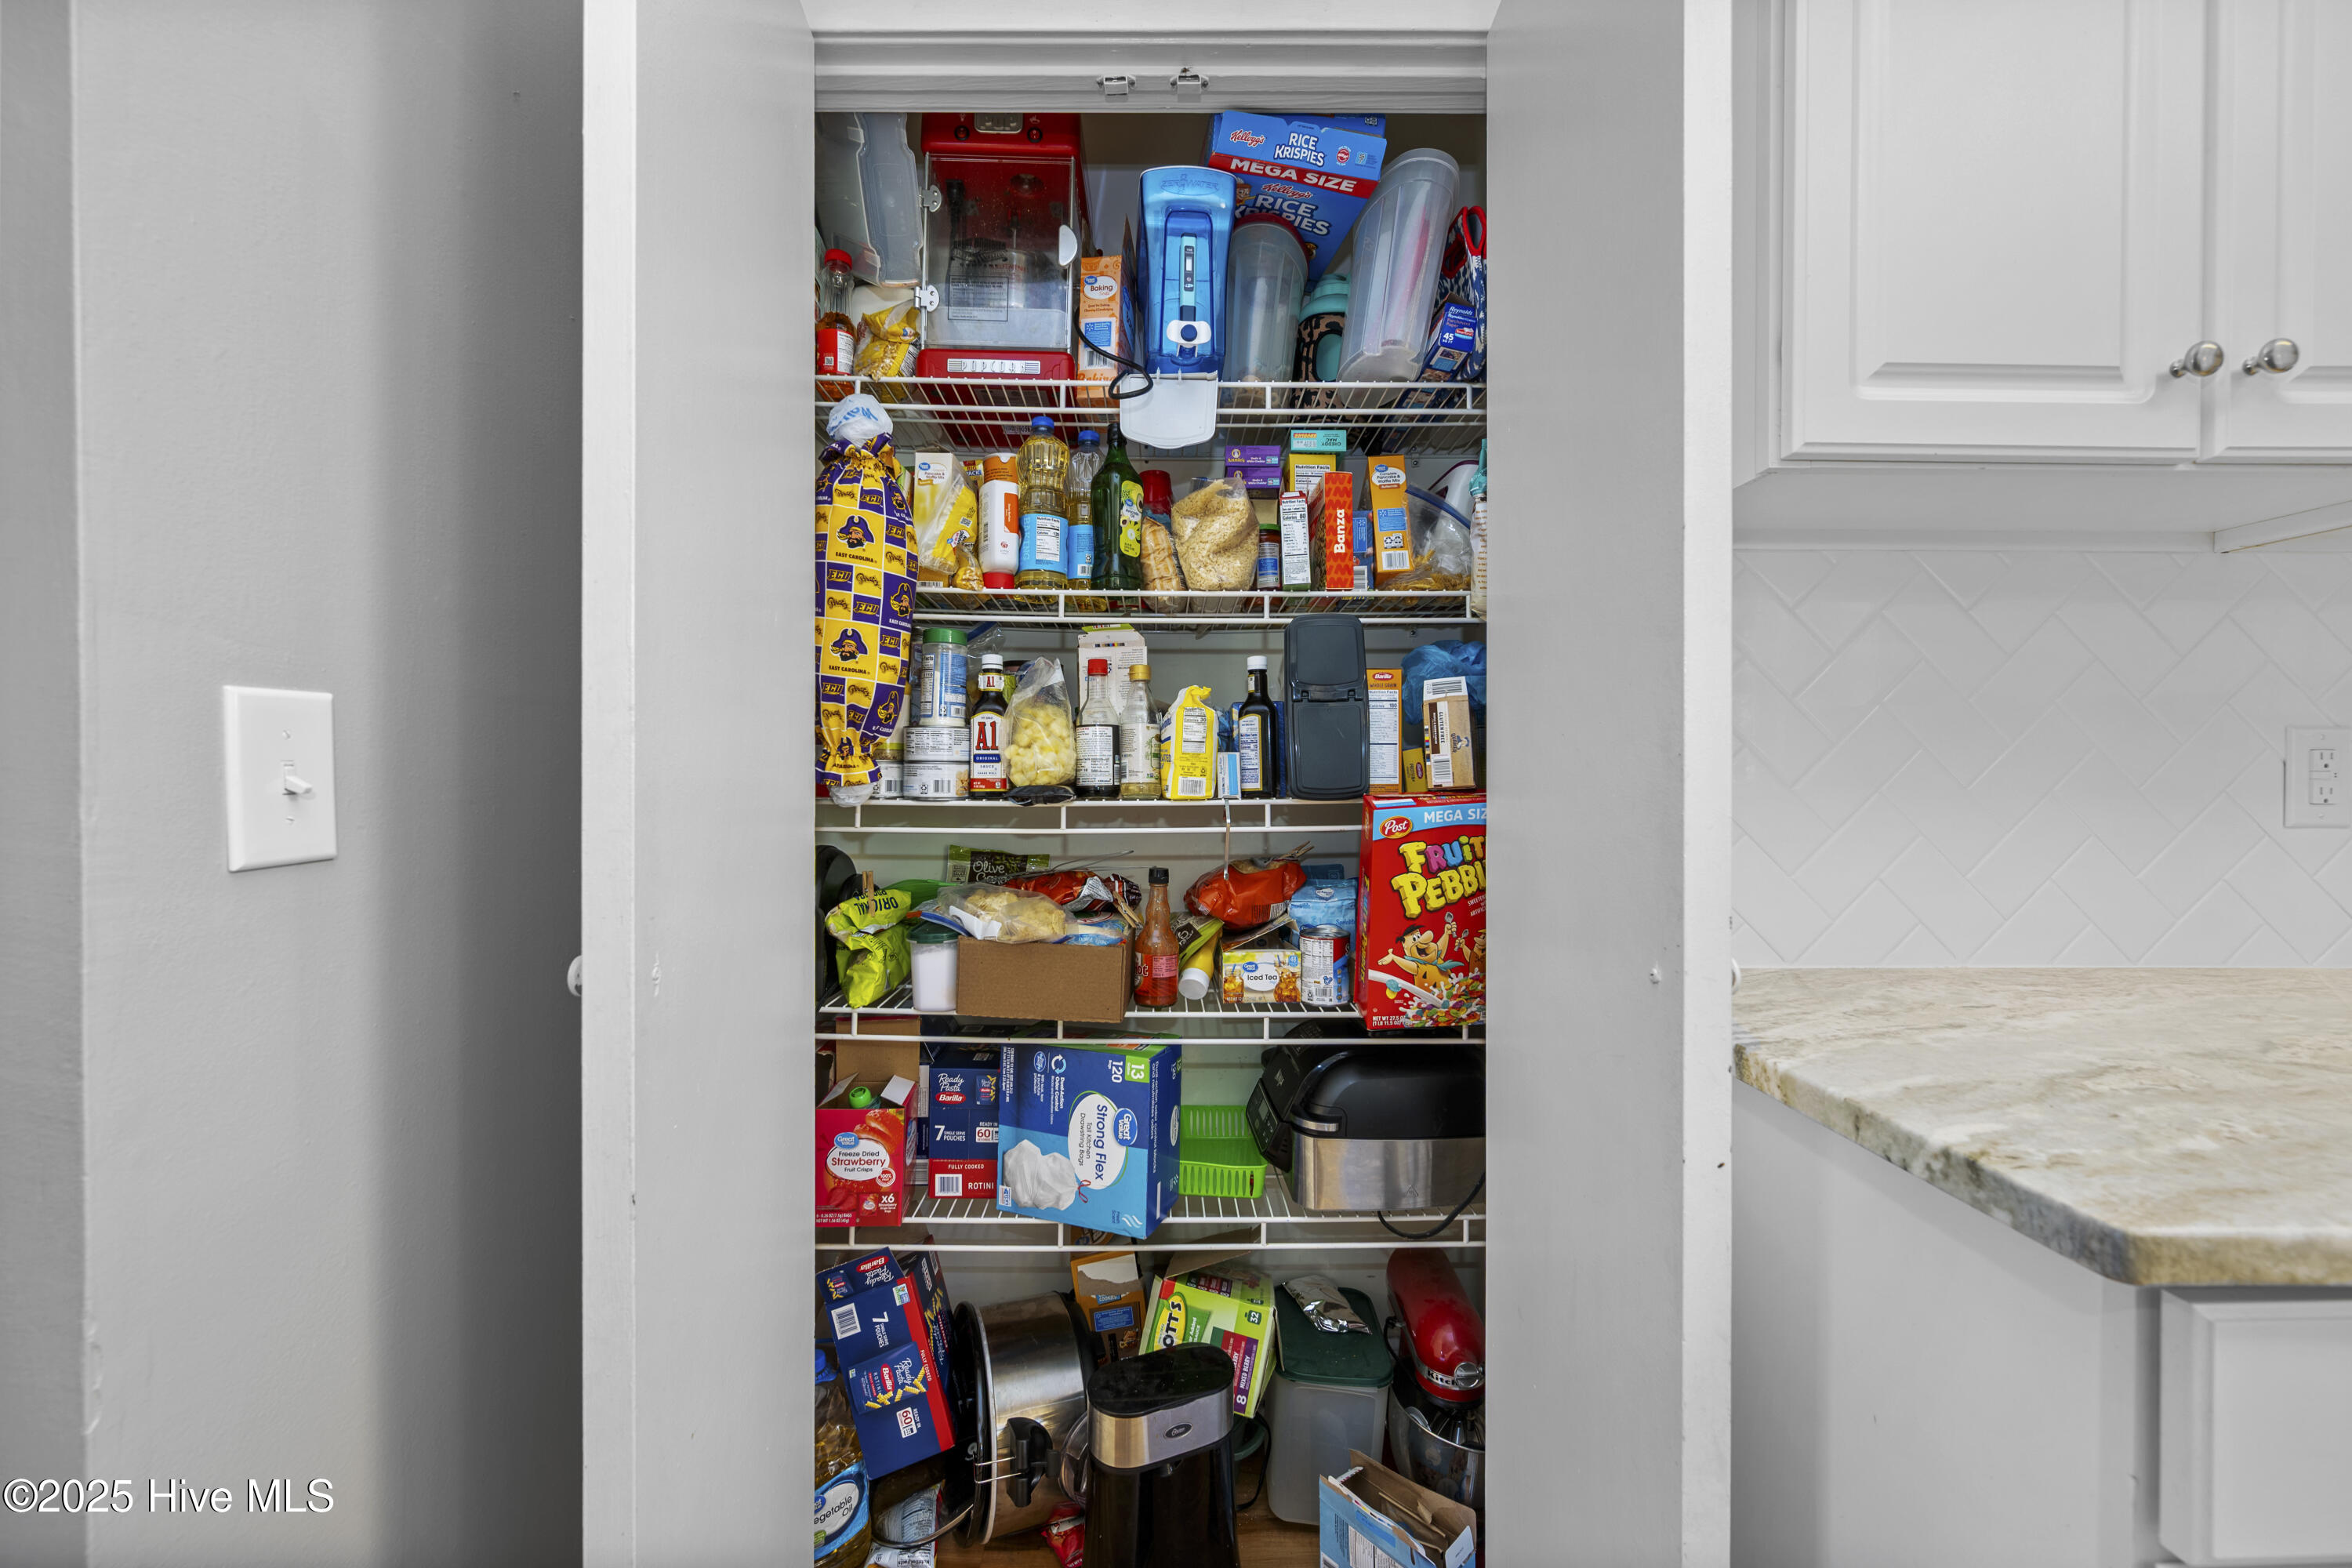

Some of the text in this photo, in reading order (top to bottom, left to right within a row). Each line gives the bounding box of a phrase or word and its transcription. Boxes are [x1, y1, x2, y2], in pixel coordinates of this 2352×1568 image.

[1230, 129, 1265, 147] Kellogg's
[1289, 132, 1318, 150] RICE
[1274, 145, 1324, 167] KRISPIES
[1231, 158, 1357, 192] MEGA SIZE
[1261, 183, 1313, 199] Kellogg's
[1254, 194, 1316, 217] RICE
[1449, 307, 1473, 315] Reynolds
[861, 495, 882, 505] ECU
[886, 524, 905, 539] ECU
[1334, 508, 1345, 554] Banza
[849, 554, 873, 563] CAROLINA
[827, 569, 852, 582] ECU
[854, 601, 879, 615] ECU
[880, 635, 899, 648] ECU
[822, 683, 844, 695] ECU
[987, 676, 995, 688] A1
[975, 721, 999, 750] A1
[1424, 809, 1463, 823] MEGA
[1385, 820, 1408, 835] Post
[973, 861, 1004, 873] Olive
[1111, 1061, 1123, 1083] 120
[1131, 1063, 1145, 1080] 13
[938, 1073, 964, 1086] Ready
[940, 1082, 960, 1091] Pasta
[935, 1125, 945, 1141] 7
[978, 1129, 990, 1138] 60
[1123, 1113, 1131, 1140] Great
[1094, 1105, 1108, 1181] Strong Flex
[832, 1157, 886, 1168] Strawberry
[881, 1193, 895, 1203] x6
[860, 1257, 885, 1271] Barilla
[866, 1265, 887, 1277] Pasta
[866, 1272, 894, 1287] Ready
[872, 1311, 889, 1323] 7
[1250, 1312, 1258, 1323] 32
[874, 1324, 884, 1348] POUCHES
[881, 1367, 892, 1390] Barilla
[894, 1363, 903, 1385] Pasta
[902, 1357, 915, 1385] Ready
[924, 1363, 932, 1381] COOKED
[1236, 1395, 1247, 1405] 8
[902, 1410, 913, 1425] 60
[842, 1504, 853, 1517] Oil
